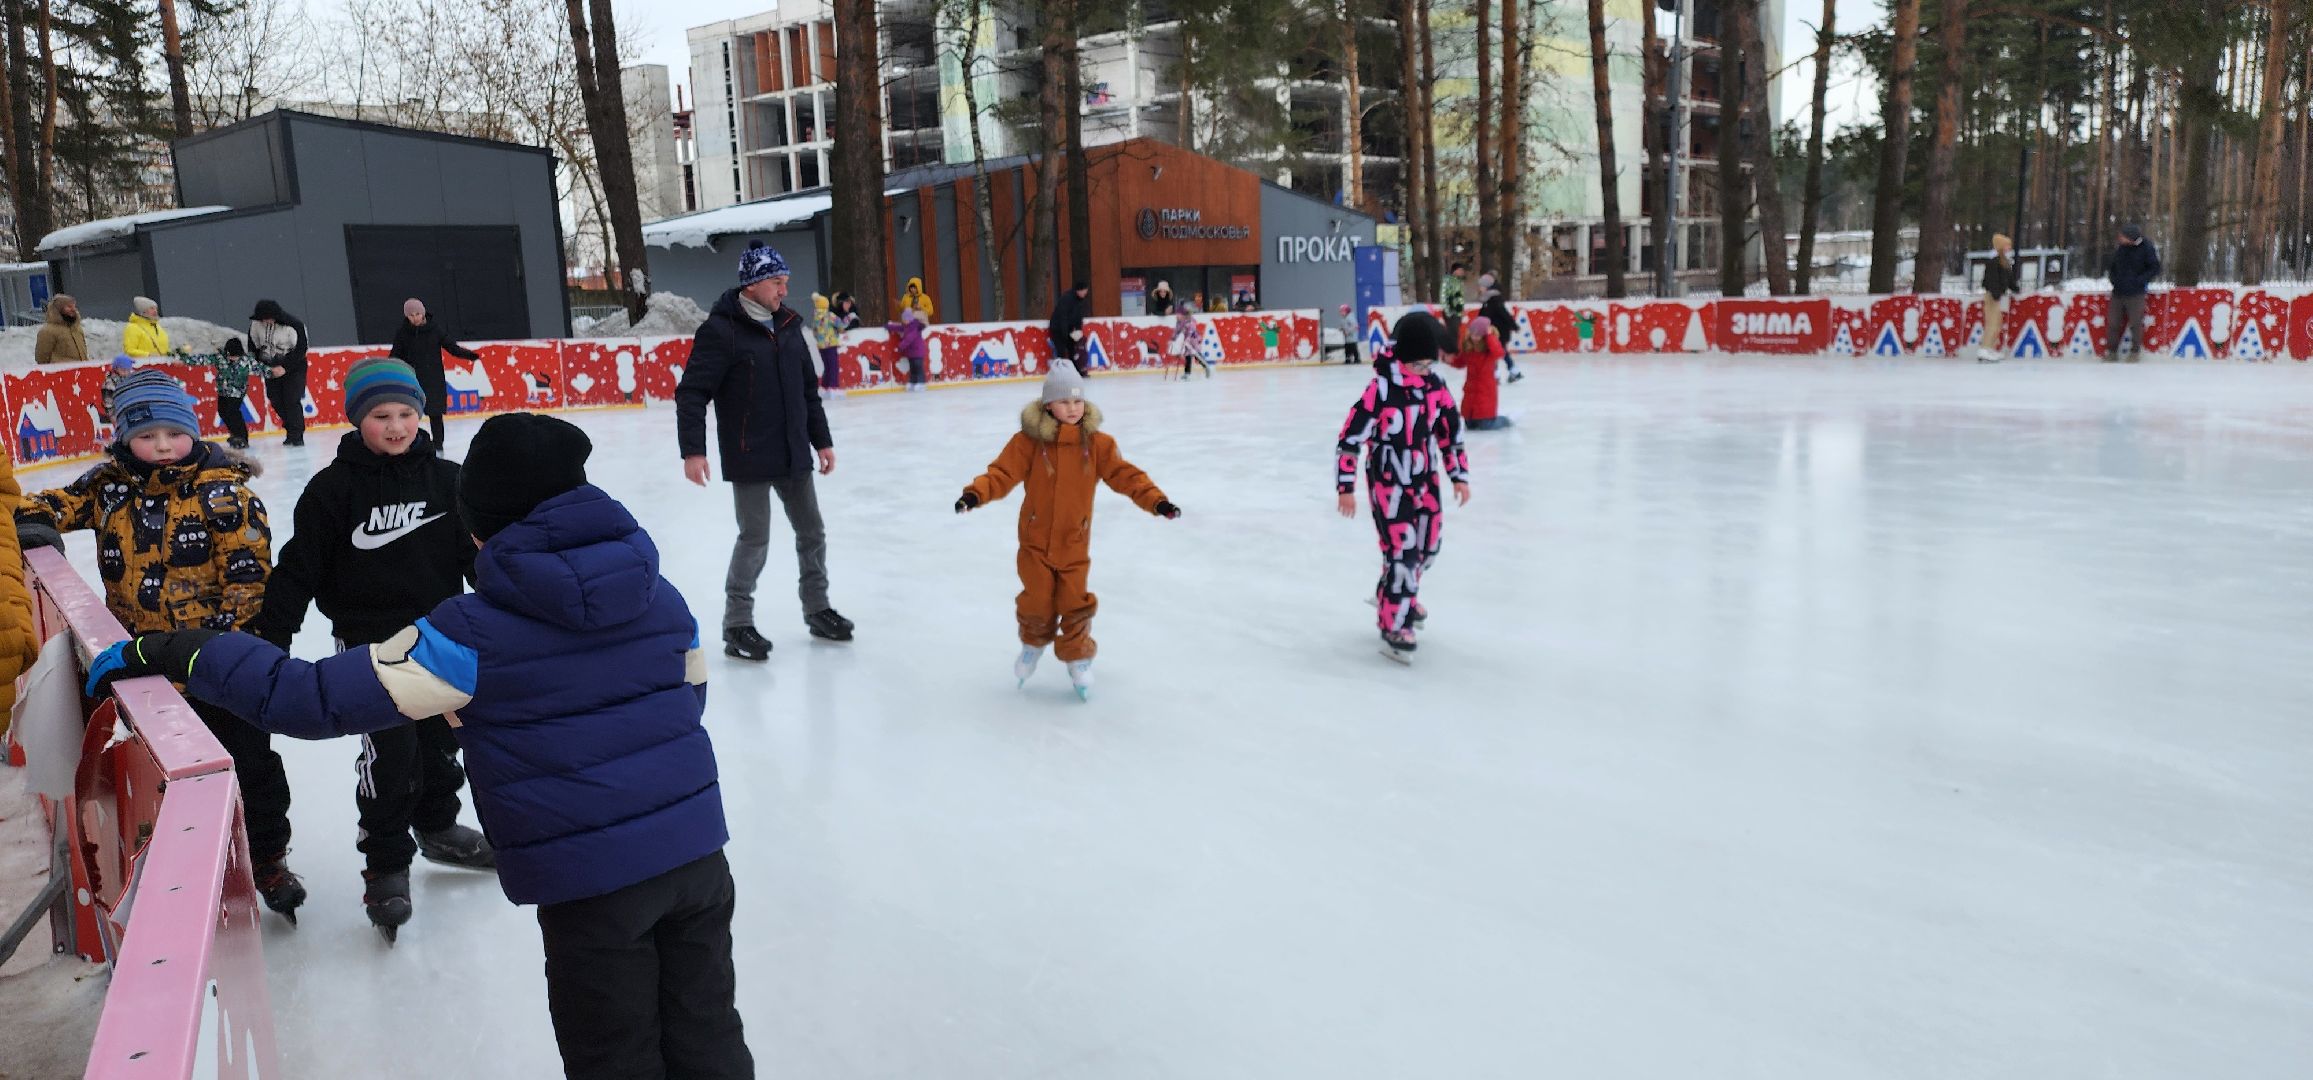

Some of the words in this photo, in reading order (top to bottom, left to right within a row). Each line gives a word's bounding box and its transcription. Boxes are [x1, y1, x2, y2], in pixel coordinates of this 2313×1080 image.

[1161, 208, 1201, 222] ПАРКИ
[1162, 225, 1249, 239] ПОДМОСКОВЬЯ
[1279, 235, 1362, 262] ПРОКАТ
[1731, 312, 1813, 335] ЗИМА
[367, 501, 427, 531] NIKE
